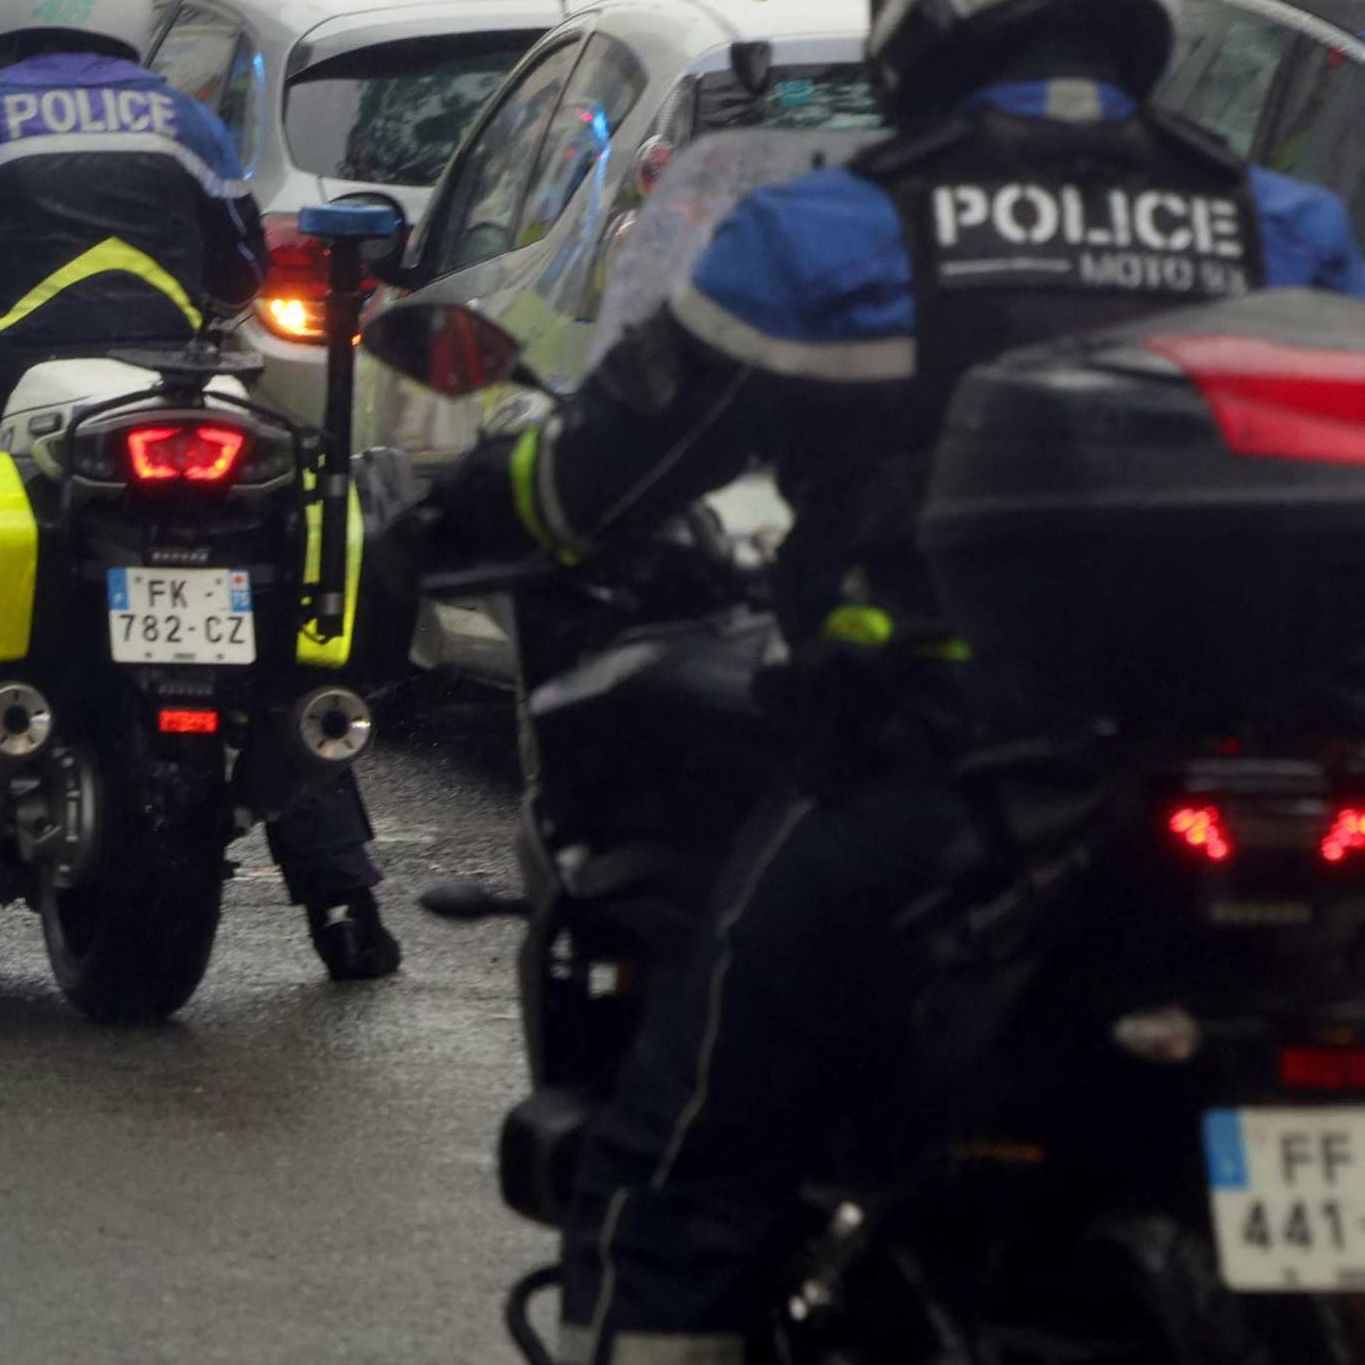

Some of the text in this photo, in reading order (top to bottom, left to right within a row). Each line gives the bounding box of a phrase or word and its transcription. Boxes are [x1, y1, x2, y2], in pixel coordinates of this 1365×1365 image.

[4, 88, 177, 139] POLICE
[933, 184, 1243, 258] POLICE
[119, 614, 247, 644] 782-CZ
[1280, 1133, 1352, 1187] FF
